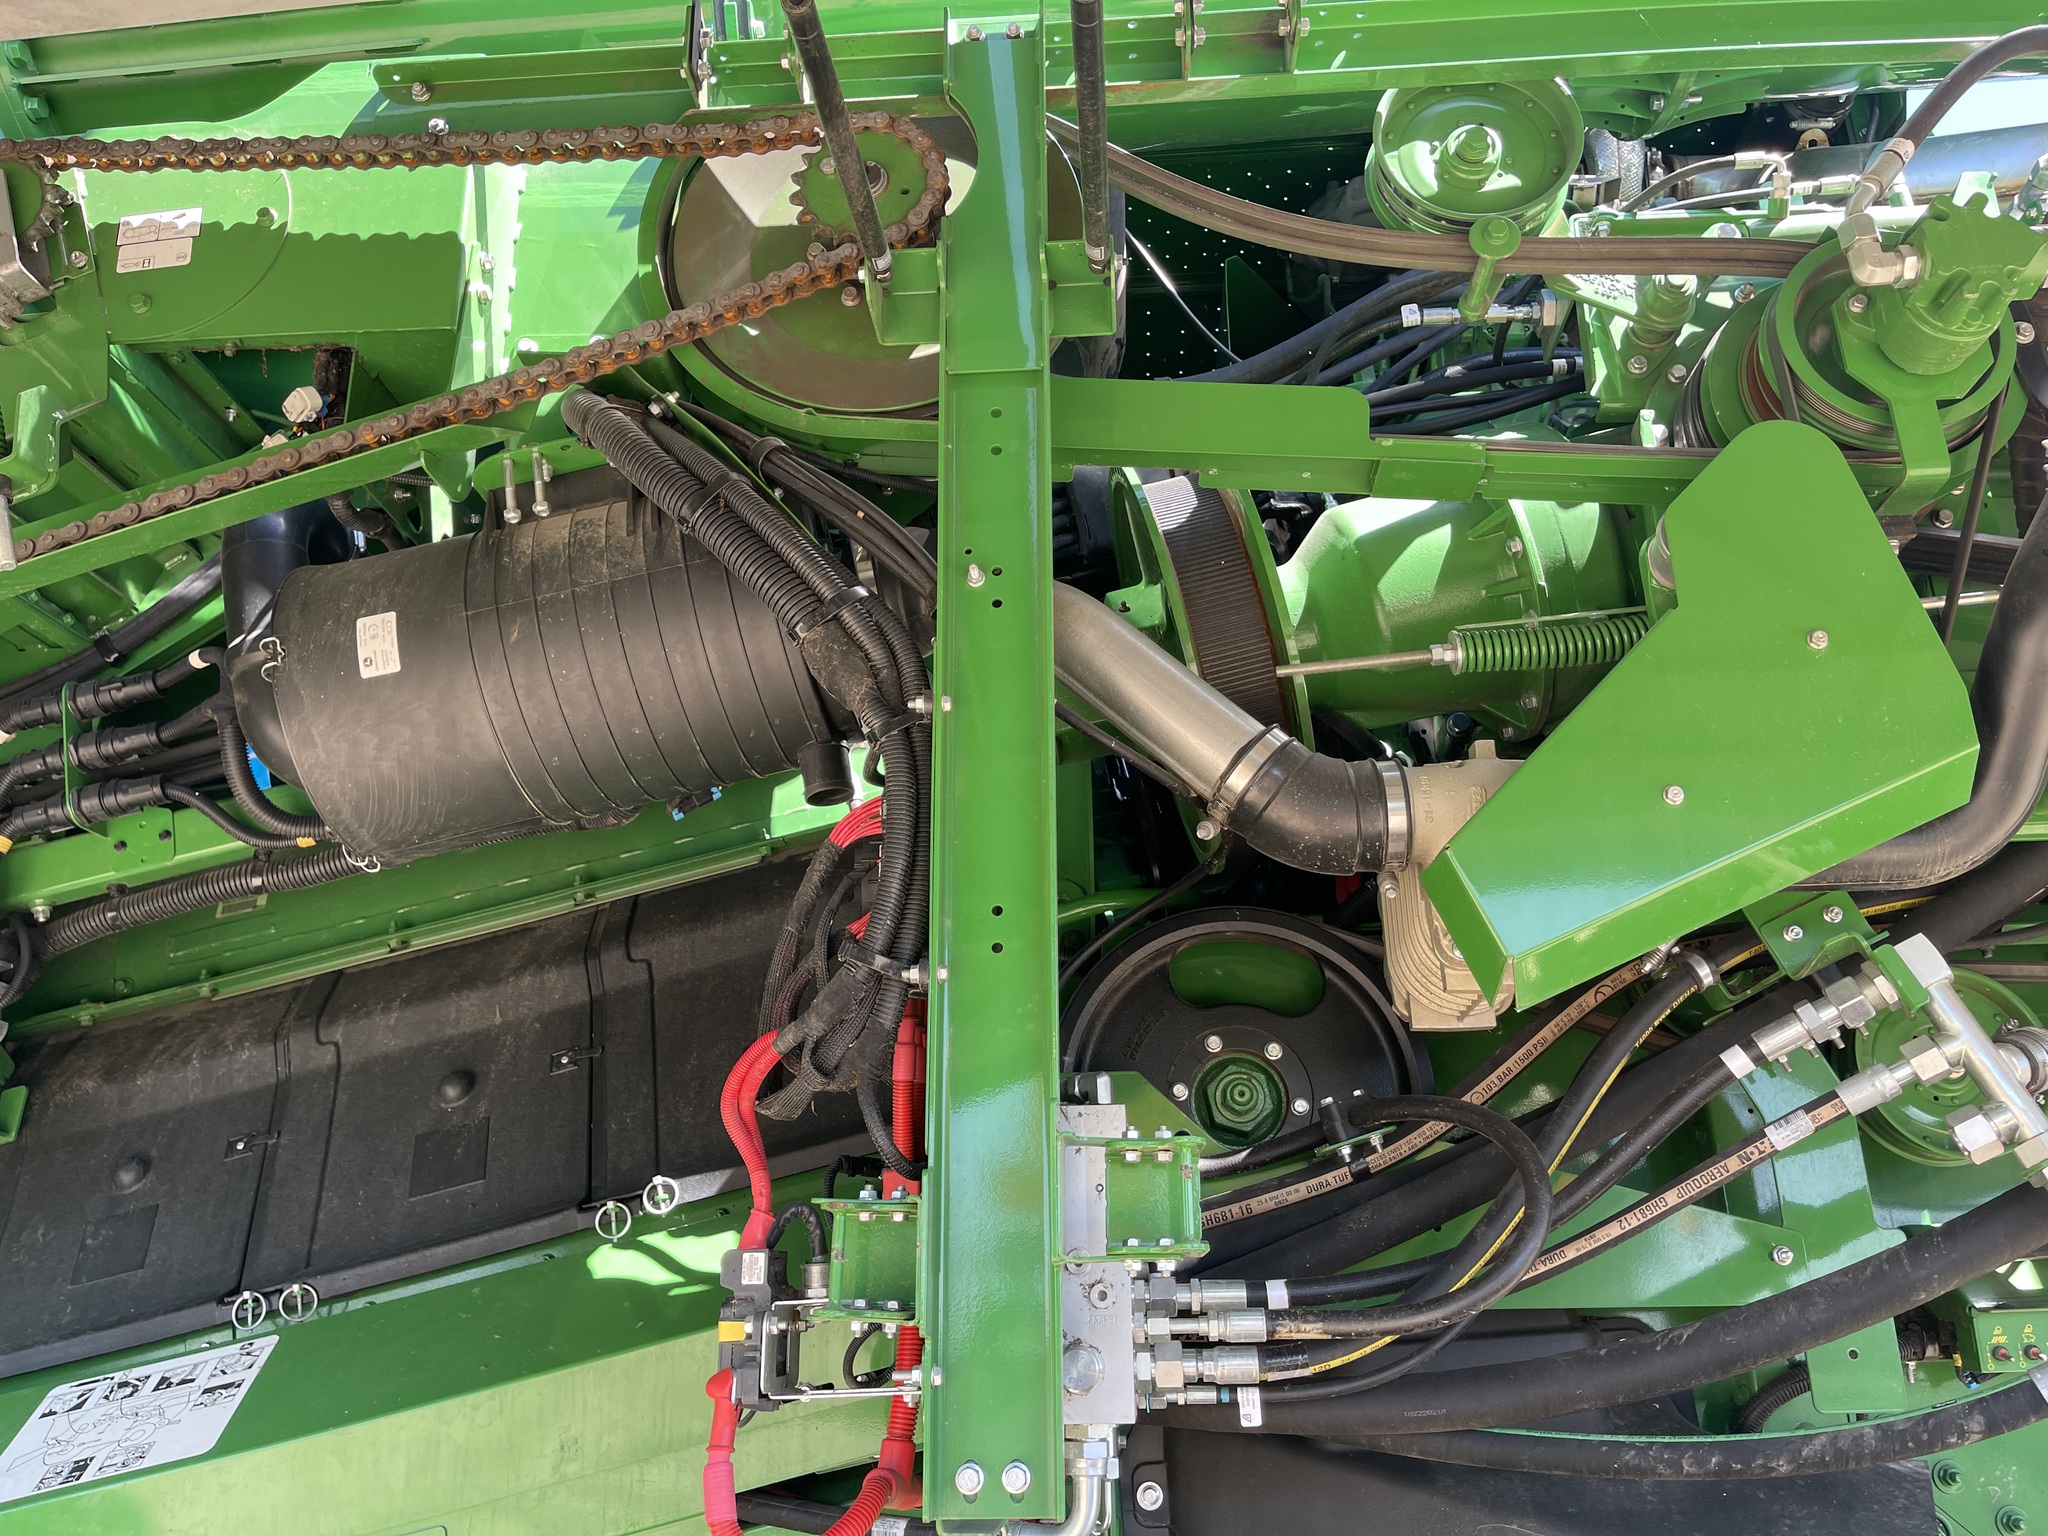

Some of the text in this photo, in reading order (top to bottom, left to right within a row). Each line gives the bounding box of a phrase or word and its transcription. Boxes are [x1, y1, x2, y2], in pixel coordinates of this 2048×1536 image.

[1482, 1035, 1549, 1095] 103 BAR (1500 PSI)
[1675, 1161, 1731, 1200] AEROQUIP
[1617, 1196, 1669, 1231] GH681-12
